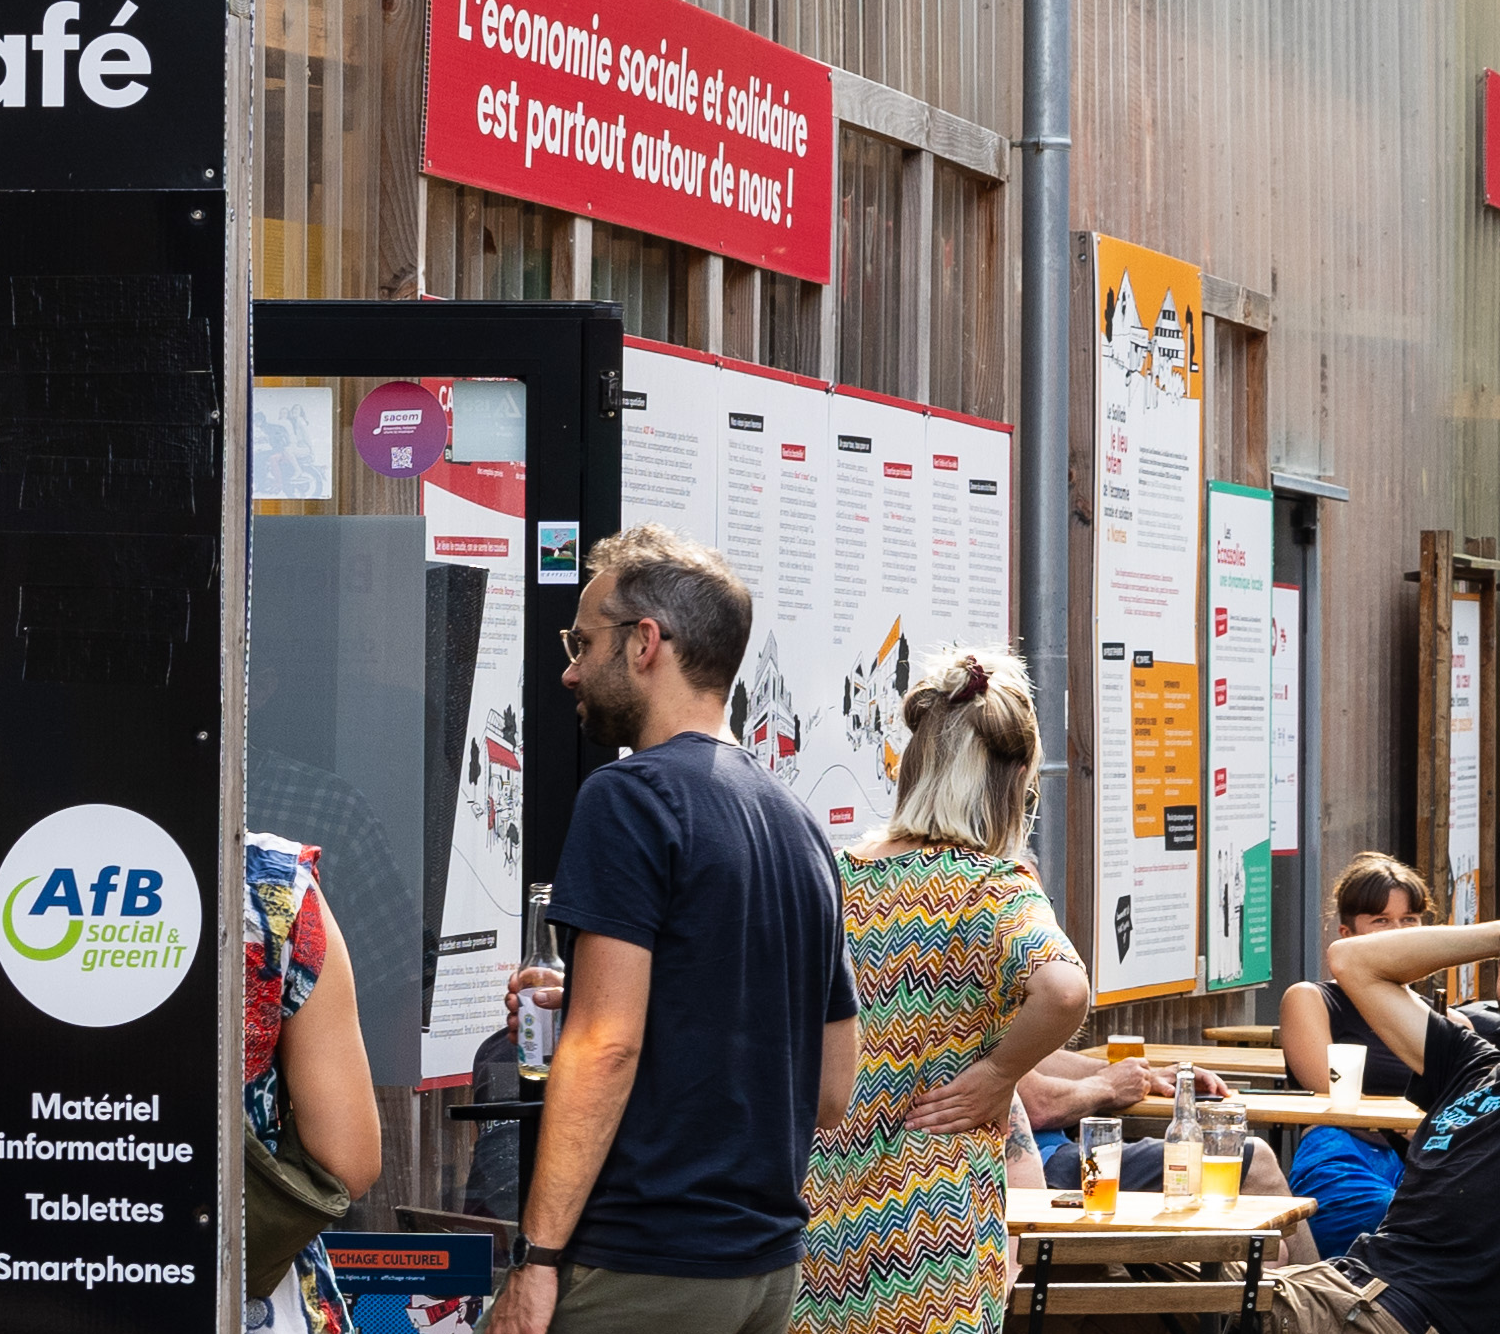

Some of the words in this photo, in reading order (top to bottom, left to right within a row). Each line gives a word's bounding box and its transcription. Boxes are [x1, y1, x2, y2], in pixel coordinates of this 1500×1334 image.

[618, 38, 699, 116] sociale
[703, 69, 724, 125] et
[726, 75, 808, 157] solidaire
[477, 81, 519, 142] est
[525, 97, 626, 172] partout
[631, 129, 706, 199] autour
[710, 142, 735, 207] de
[738, 167, 782, 225] nous
[383, 412, 419, 422] sacem
[28, 865, 164, 917] AfB
[85, 920, 162, 943] social
[167, 927, 180, 944] &
[81, 948, 157, 972] green
[161, 945, 187, 968] IT
[32, 1093, 160, 1122] Matériel
[25, 1193, 164, 1222] Tablettes
[328, 1252, 379, 1266] FICHAGE
[382, 1253, 444, 1267] CULTUREL
